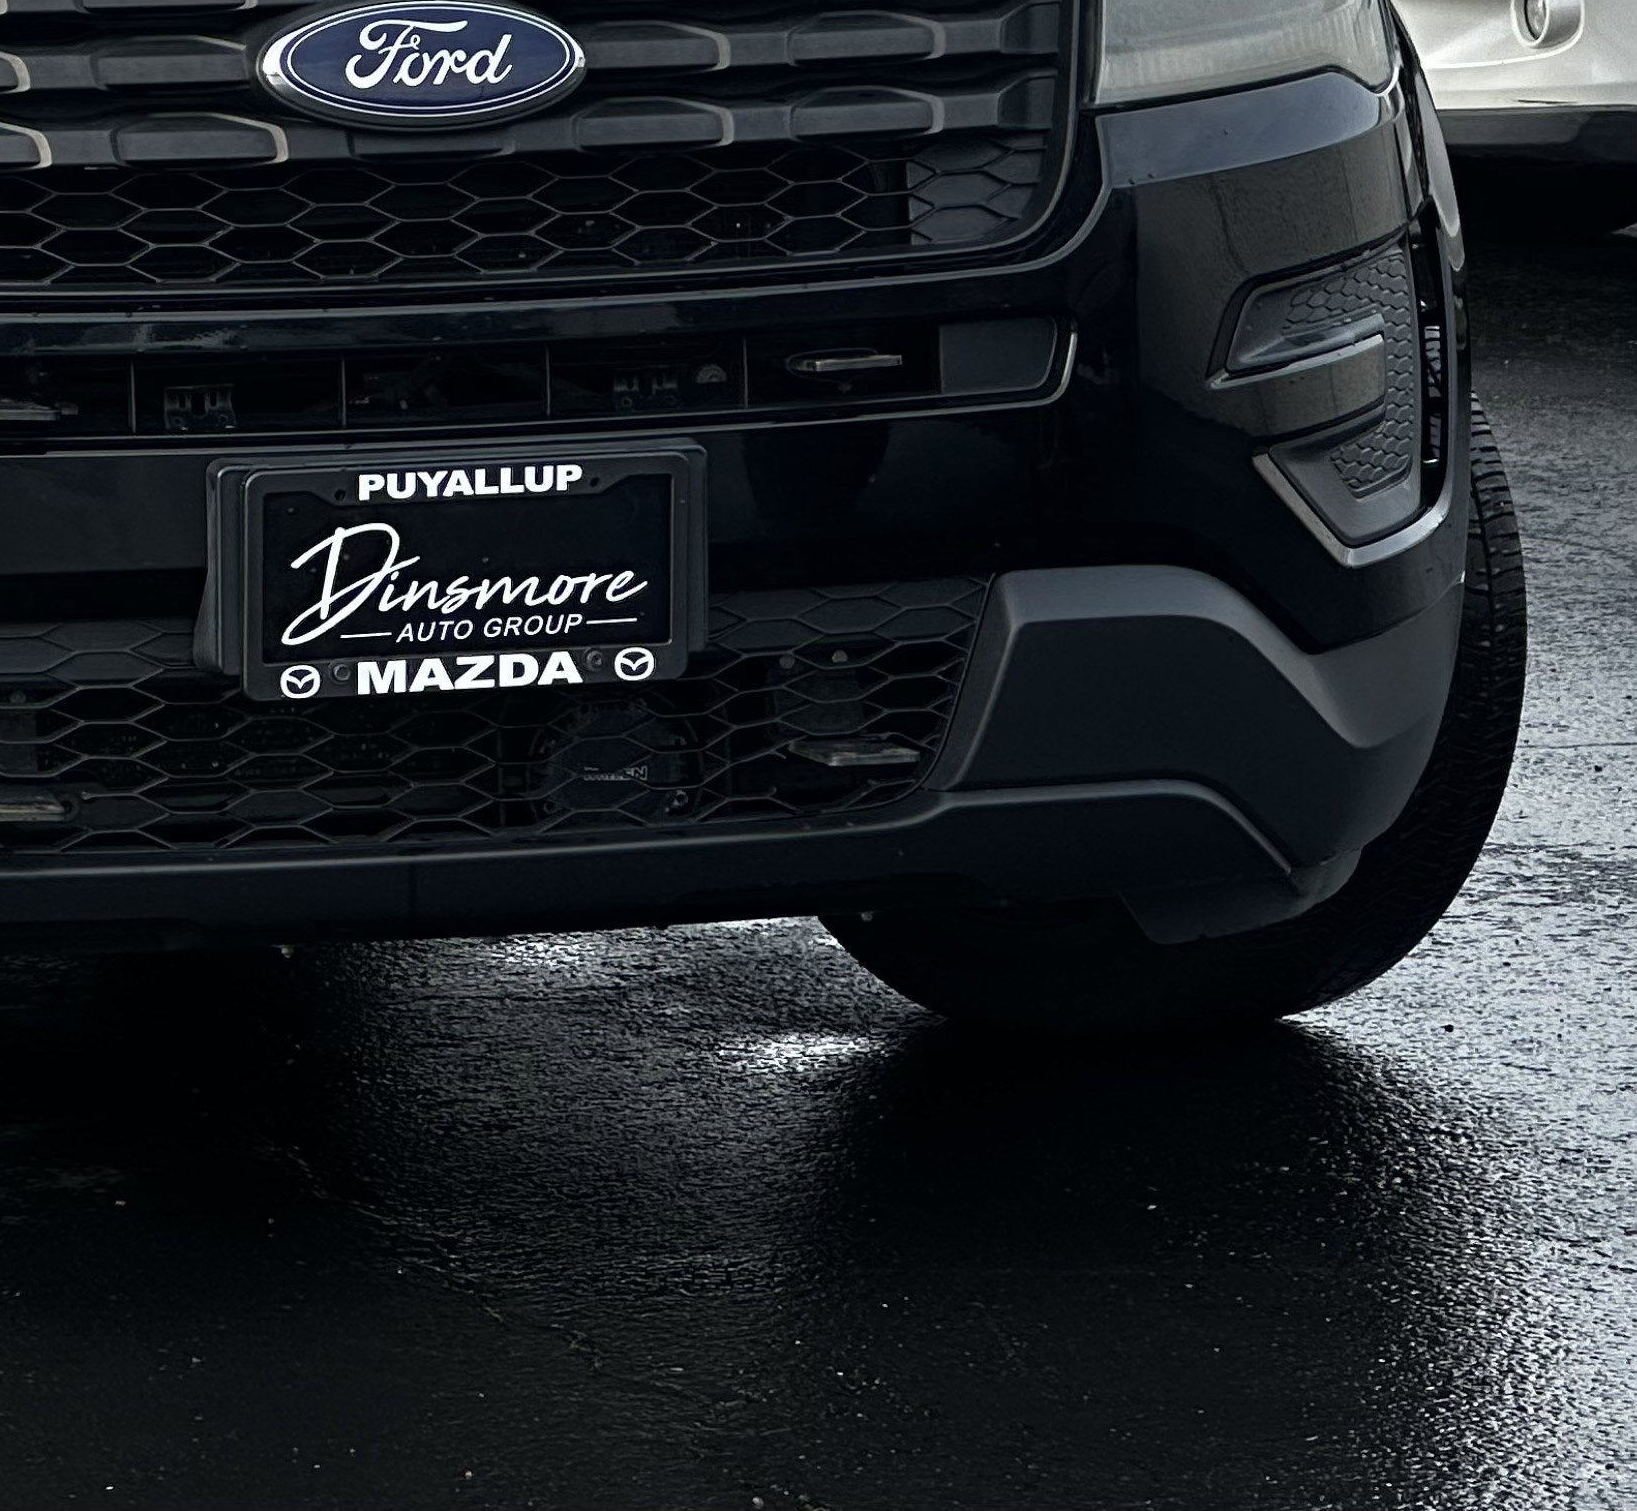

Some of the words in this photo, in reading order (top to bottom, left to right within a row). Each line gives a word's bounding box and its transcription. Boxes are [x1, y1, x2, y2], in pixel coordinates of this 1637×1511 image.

[344, 18, 514, 89] Ford
[358, 464, 583, 501] PUYALLUP
[281, 522, 648, 647] Dinsmore
[395, 620, 474, 643] AUTO
[483, 613, 583, 638] GROUP
[357, 651, 584, 695] MAZDA
